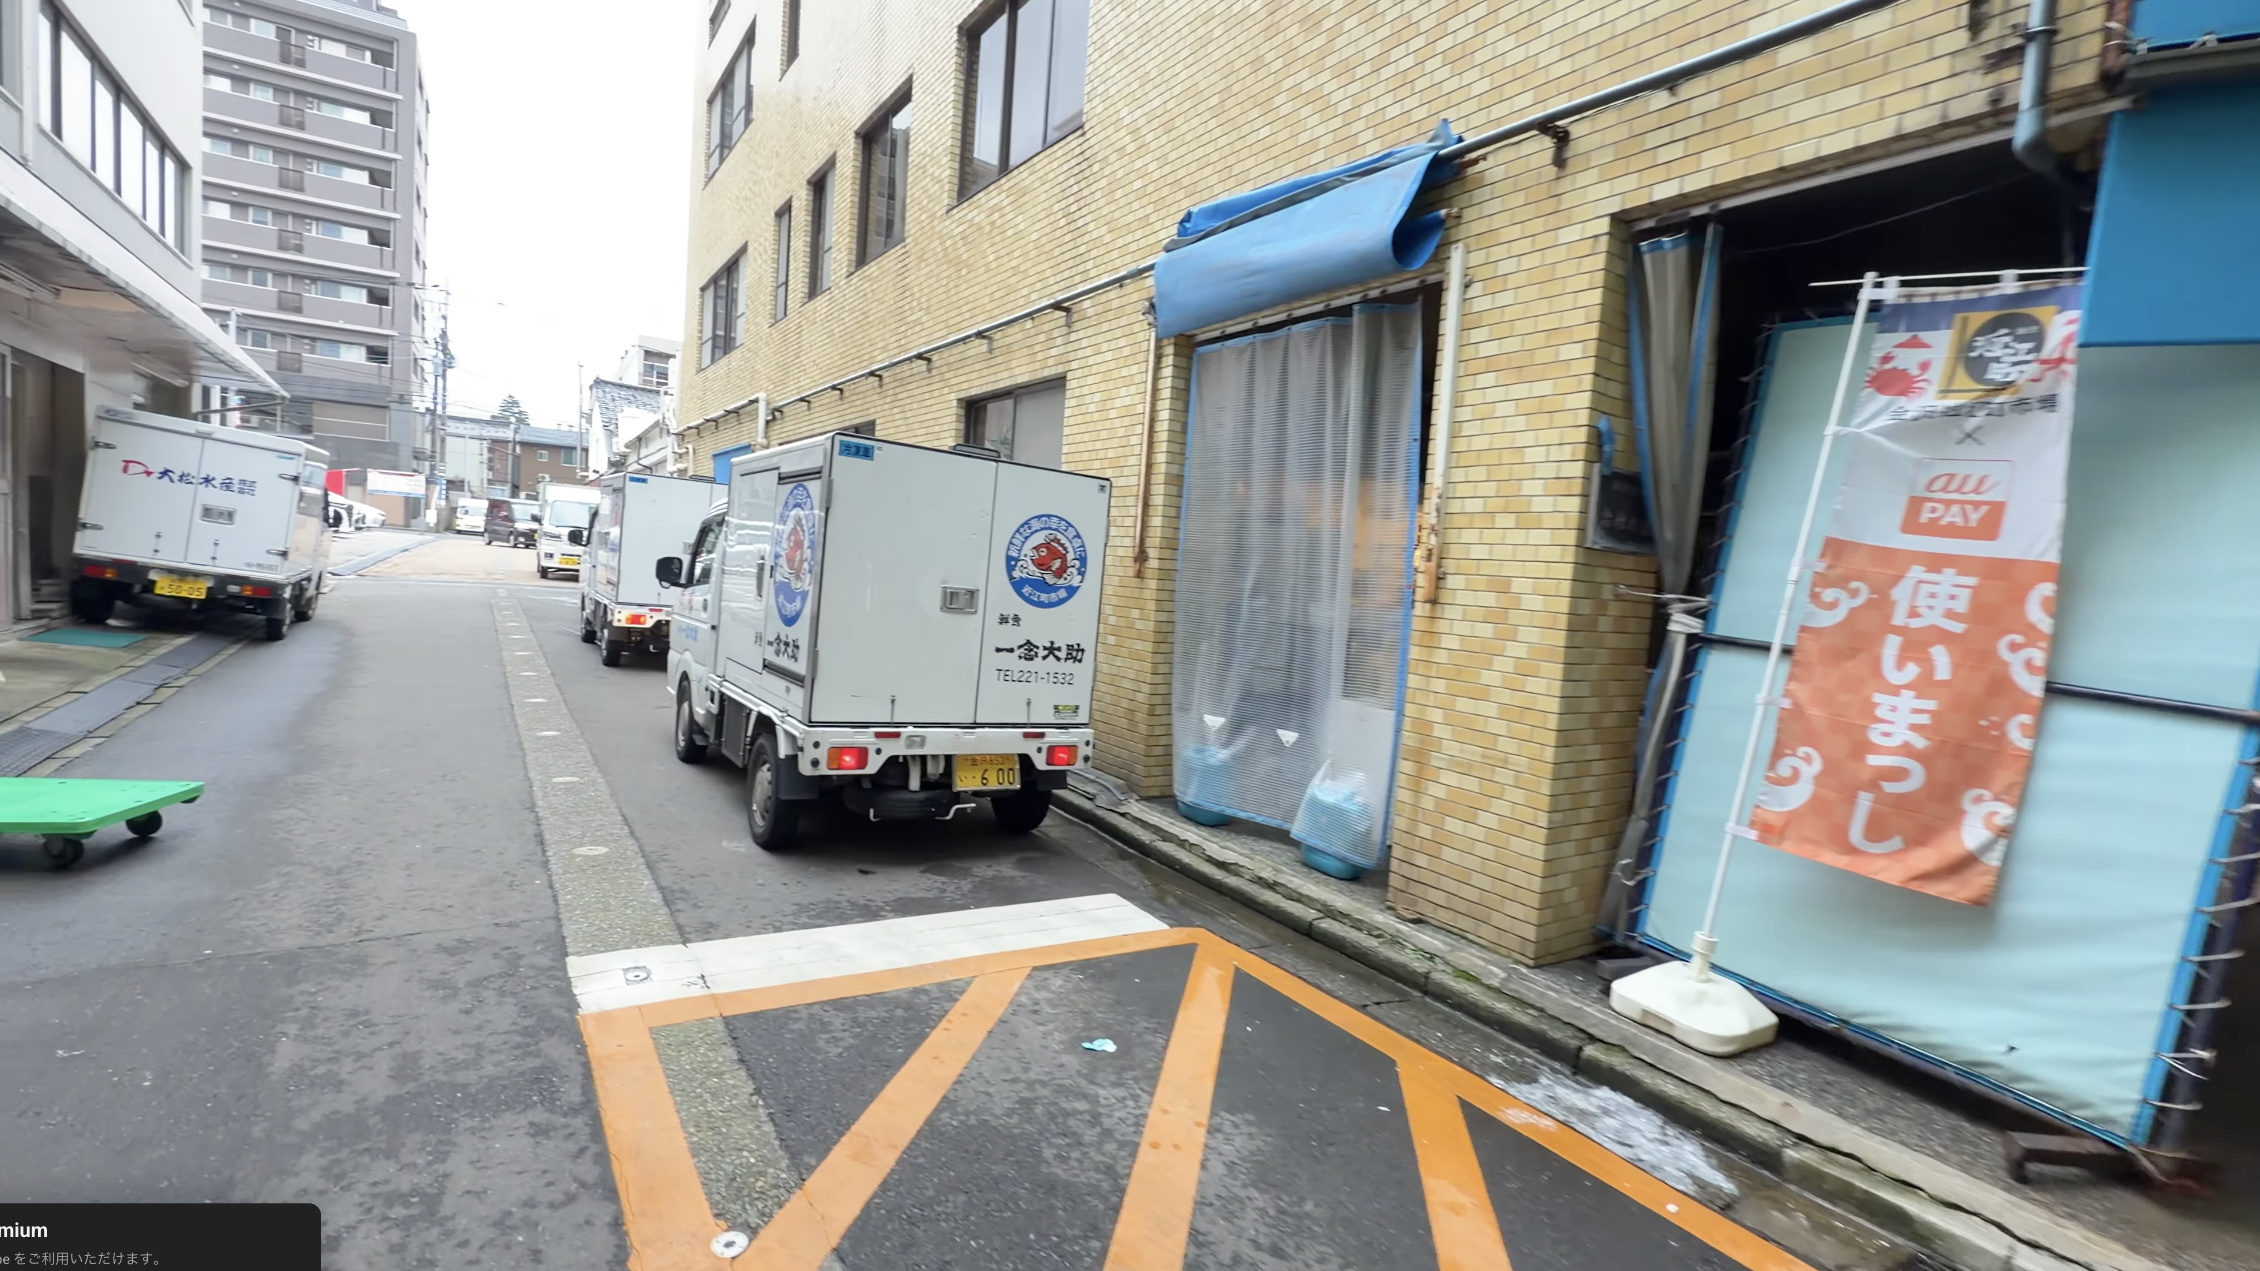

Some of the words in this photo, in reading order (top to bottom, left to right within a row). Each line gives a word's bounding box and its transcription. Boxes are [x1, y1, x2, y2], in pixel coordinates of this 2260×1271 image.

[157, 467, 236, 493] 大松水産
[1924, 472, 2000, 495] au
[1918, 502, 1991, 527] PAY
[994, 638, 1086, 664] 一念大助
